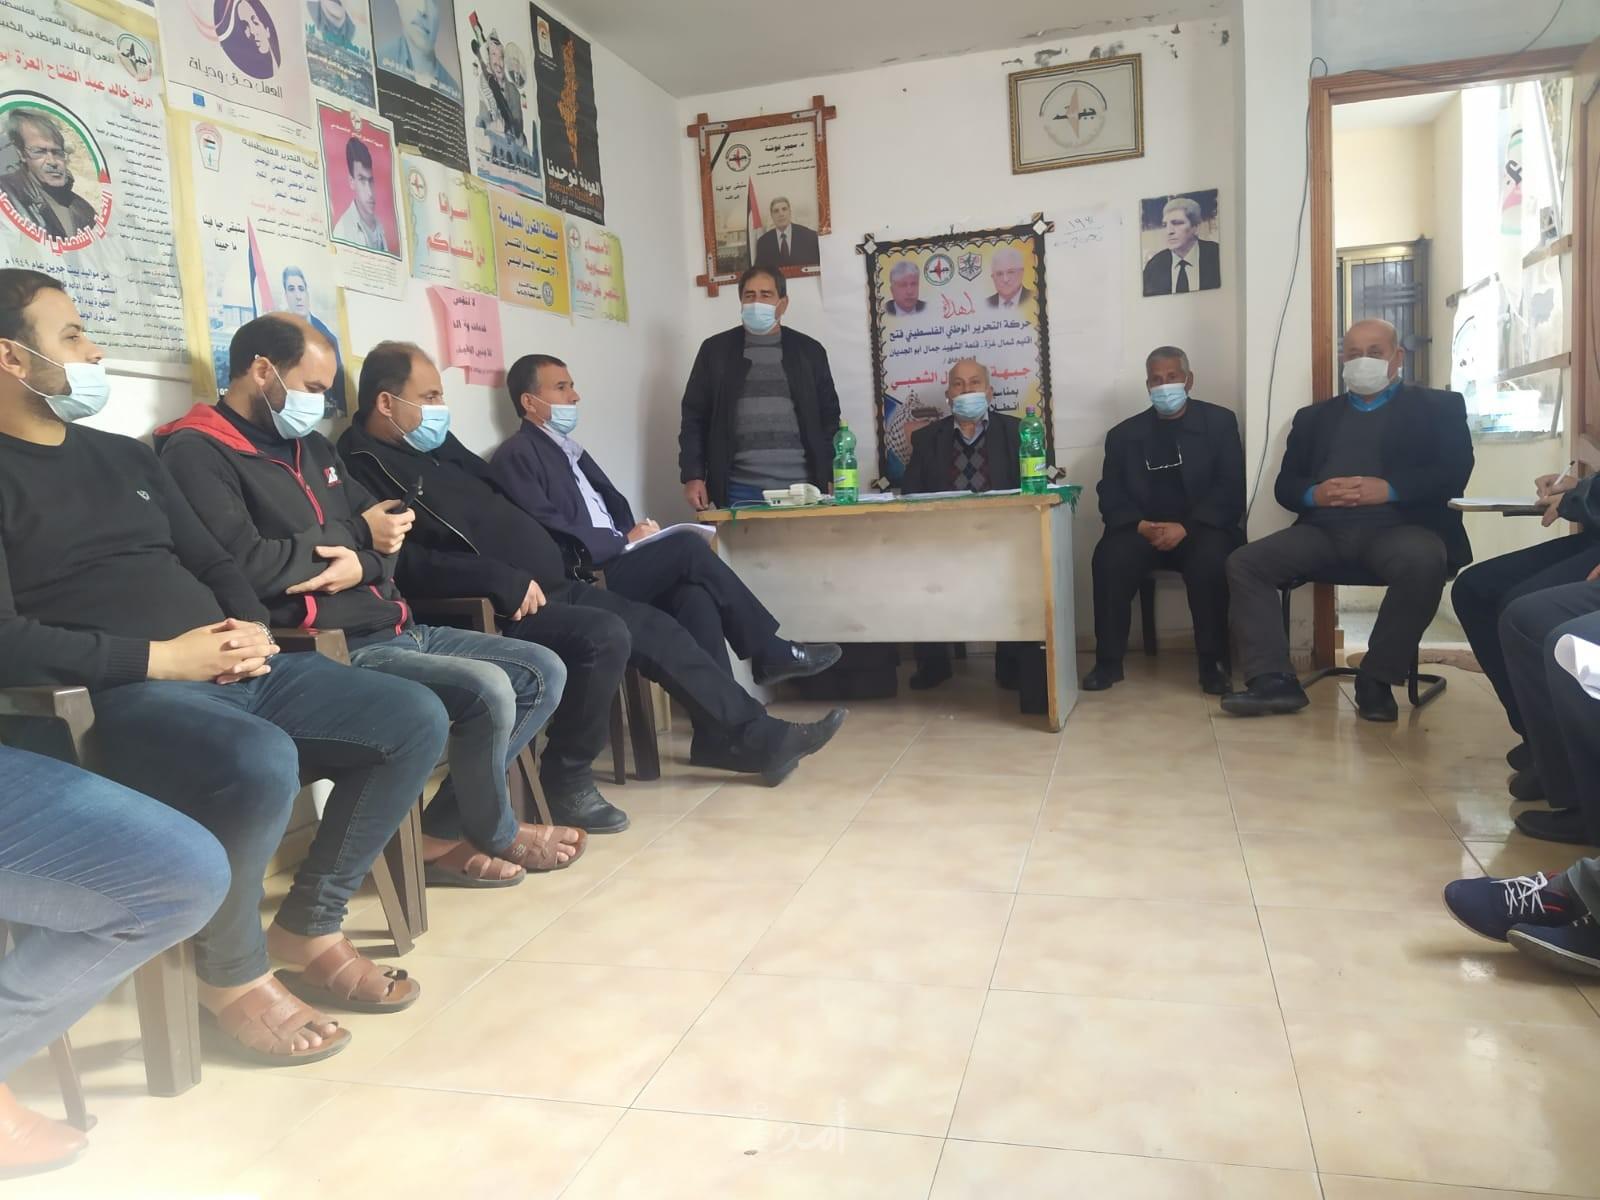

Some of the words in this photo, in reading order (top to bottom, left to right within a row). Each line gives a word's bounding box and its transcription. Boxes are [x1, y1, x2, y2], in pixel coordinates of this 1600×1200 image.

[25, 29, 61, 47] الوطني
[47, 62, 81, 80] الفتاح
[85, 77, 105, 92] عبد
[108, 82, 130, 98] خالد
[946, 324, 971, 338] الوطني
[972, 321, 1002, 334] التحرير
[1004, 319, 1031, 330] حركة
[889, 331, 904, 342] فتح
[905, 327, 945, 343] الفلسطيني
[923, 344, 941, 354] جمال
[942, 341, 963, 352] الشهيد
[997, 337, 1015, 348] شمال
[890, 369, 938, 391] الشعبي
[990, 366, 1031, 380] جبهة
